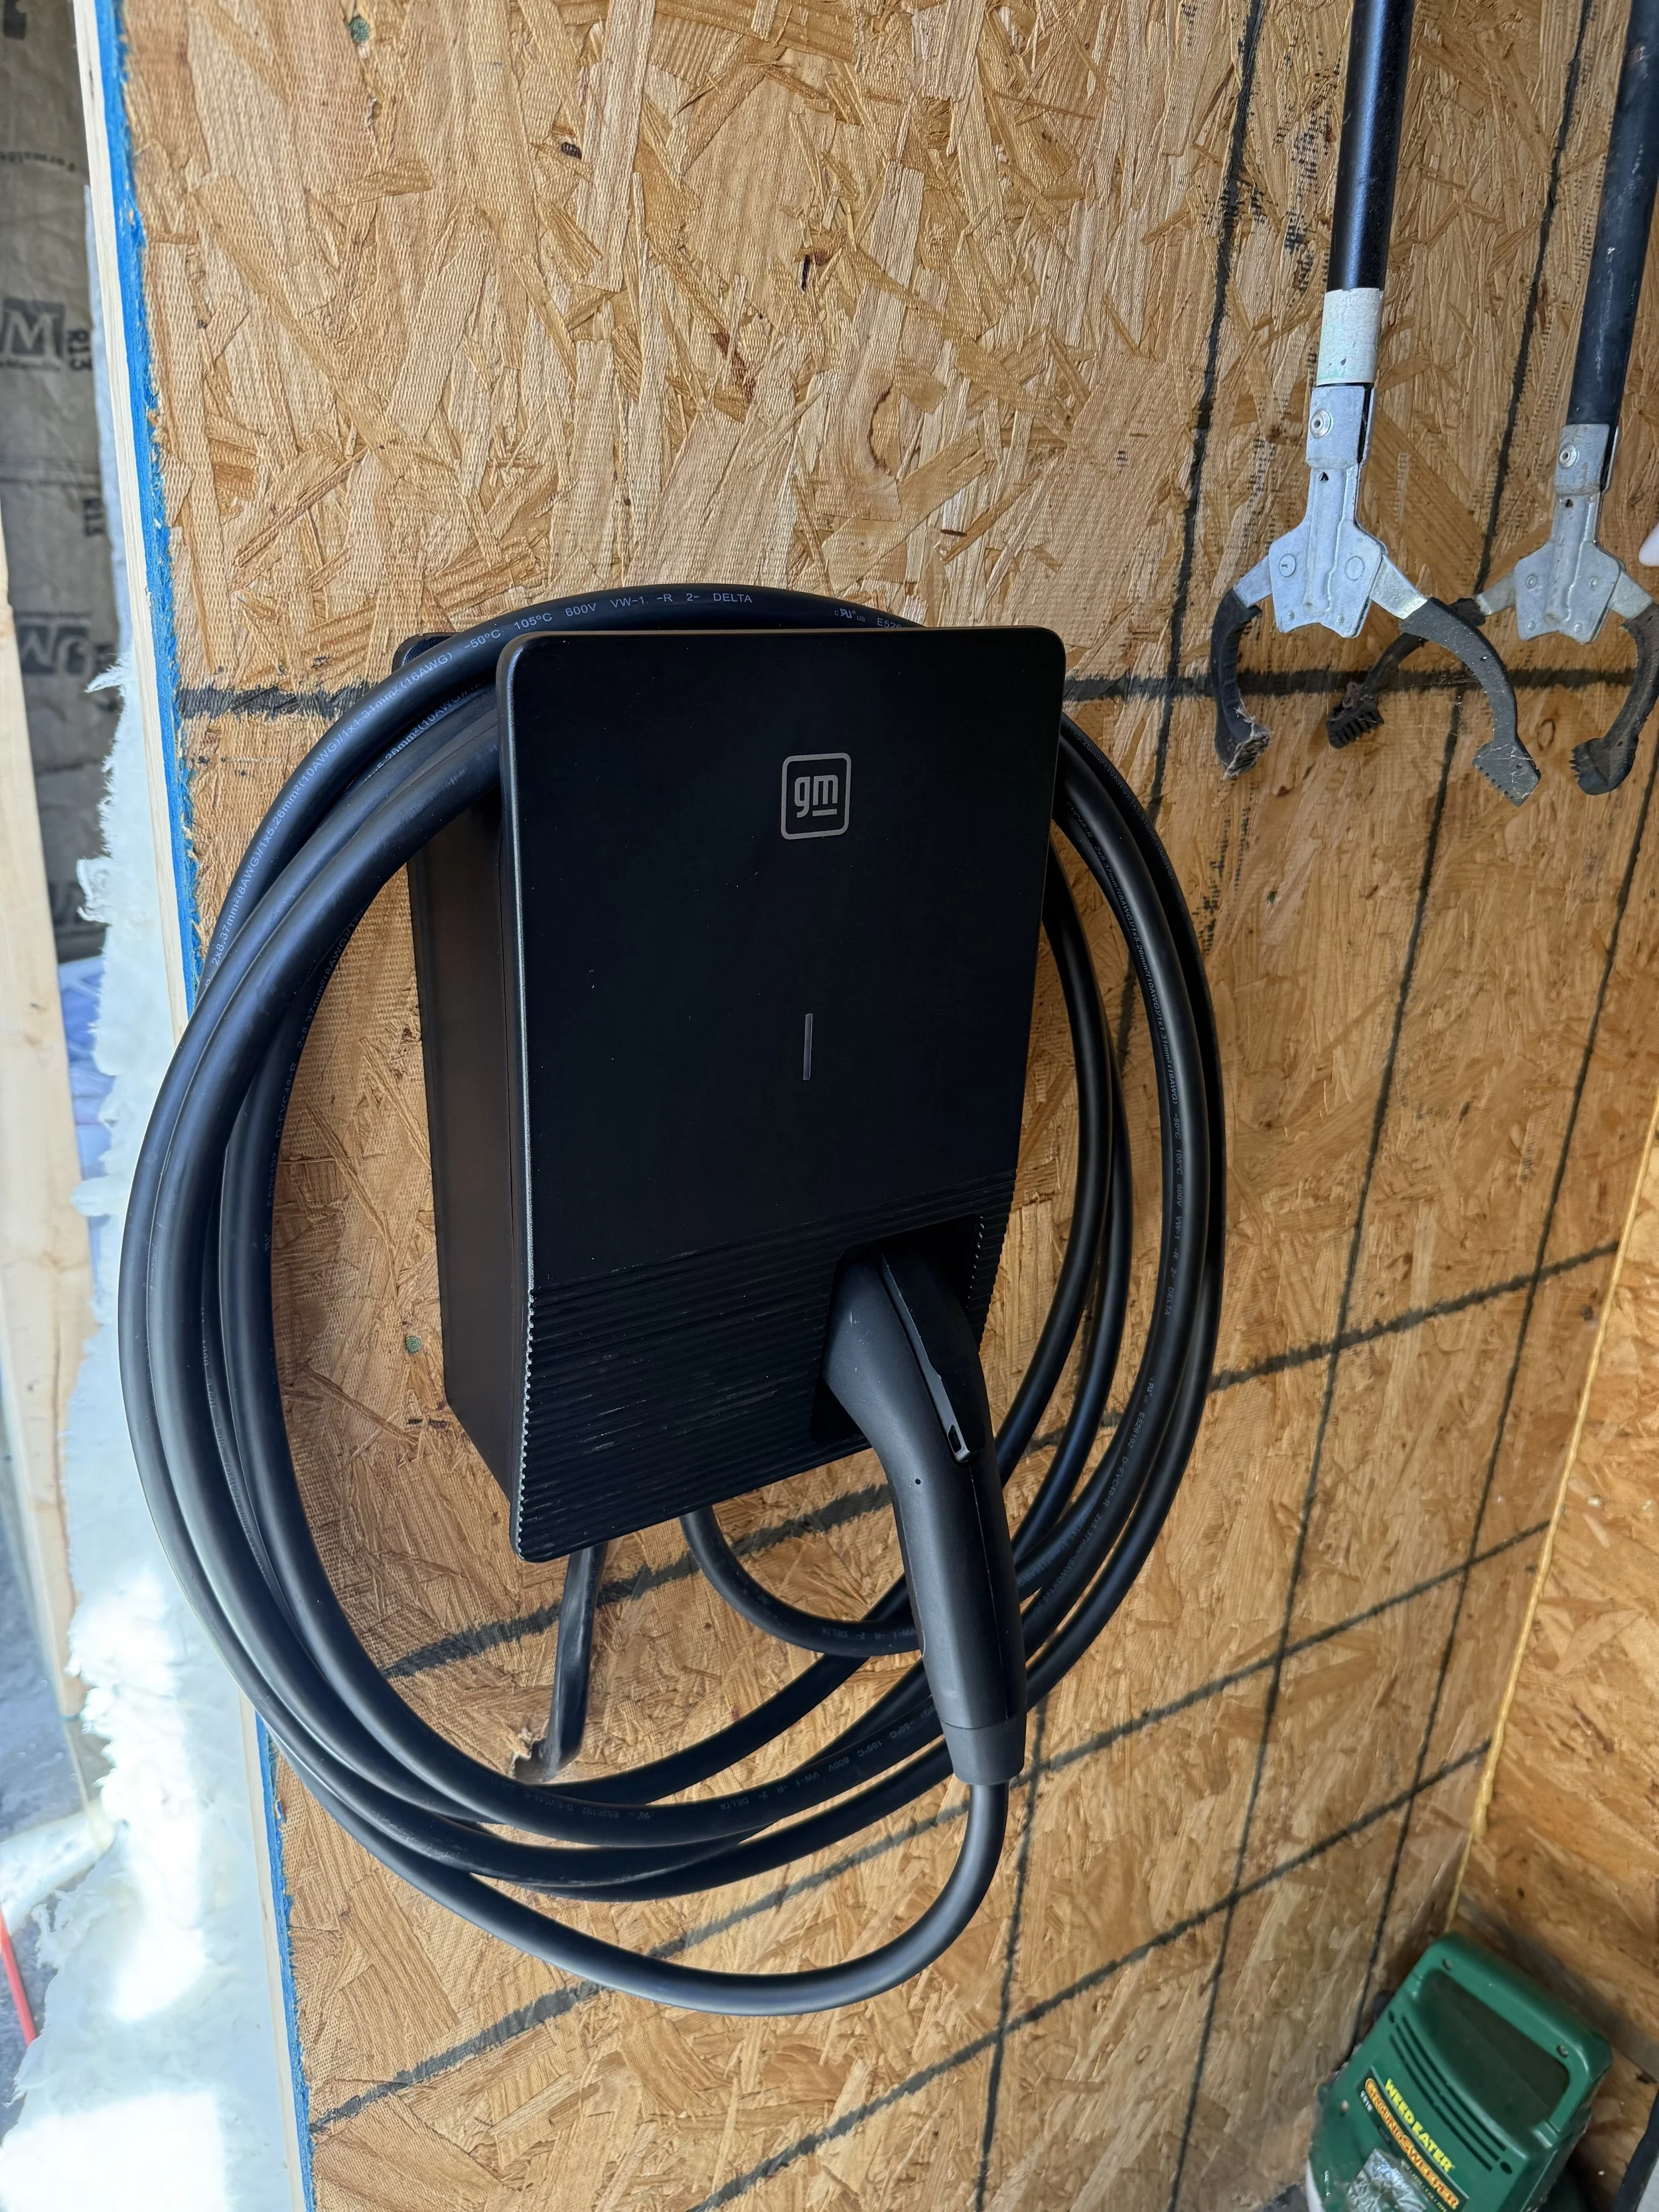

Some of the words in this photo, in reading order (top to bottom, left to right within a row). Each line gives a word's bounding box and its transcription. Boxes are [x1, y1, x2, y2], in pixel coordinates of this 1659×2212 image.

[565, 603, 597, 617] 600V
[713, 593, 753, 603] DELTA
[794, 774, 838, 818] gm
[1164, 1286, 1174, 1315] DELTA
[719, 1796, 749, 1810] DELTA
[1385, 2078, 1415, 2125] WEED
[1411, 2120, 1452, 2173] EATER
